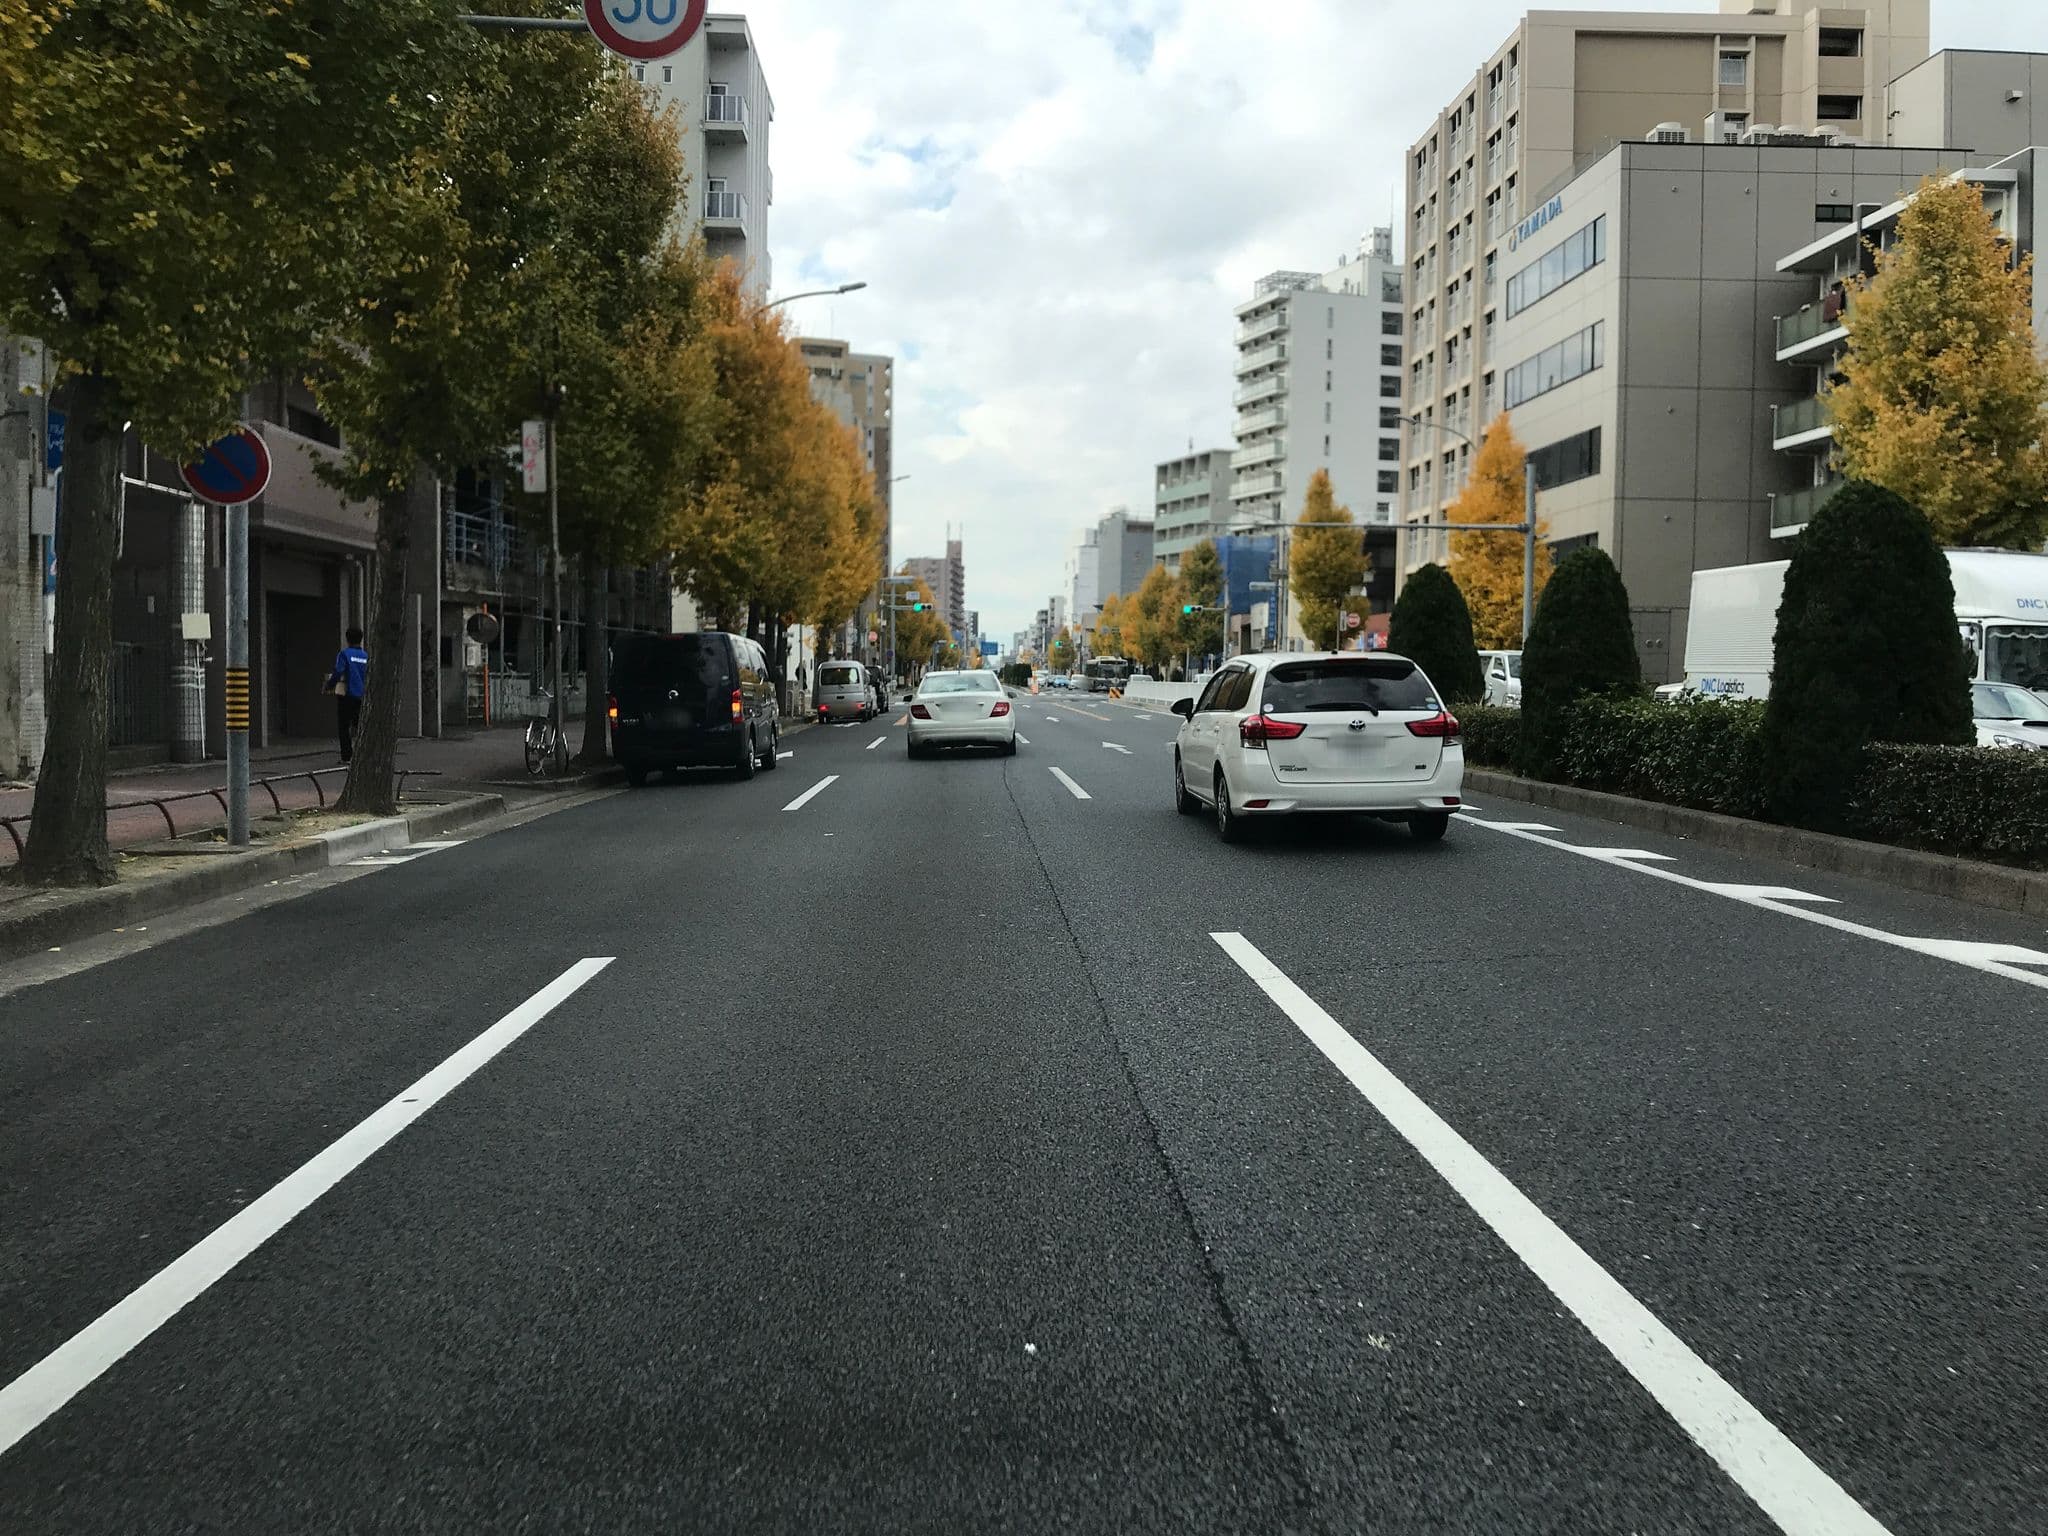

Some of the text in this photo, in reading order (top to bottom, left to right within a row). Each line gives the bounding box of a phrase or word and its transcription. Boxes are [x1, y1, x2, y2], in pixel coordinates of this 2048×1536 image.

[1518, 195, 1562, 243] YAMADA
[2016, 598, 2044, 609] DNC
[1701, 678, 1717, 693] DNC
